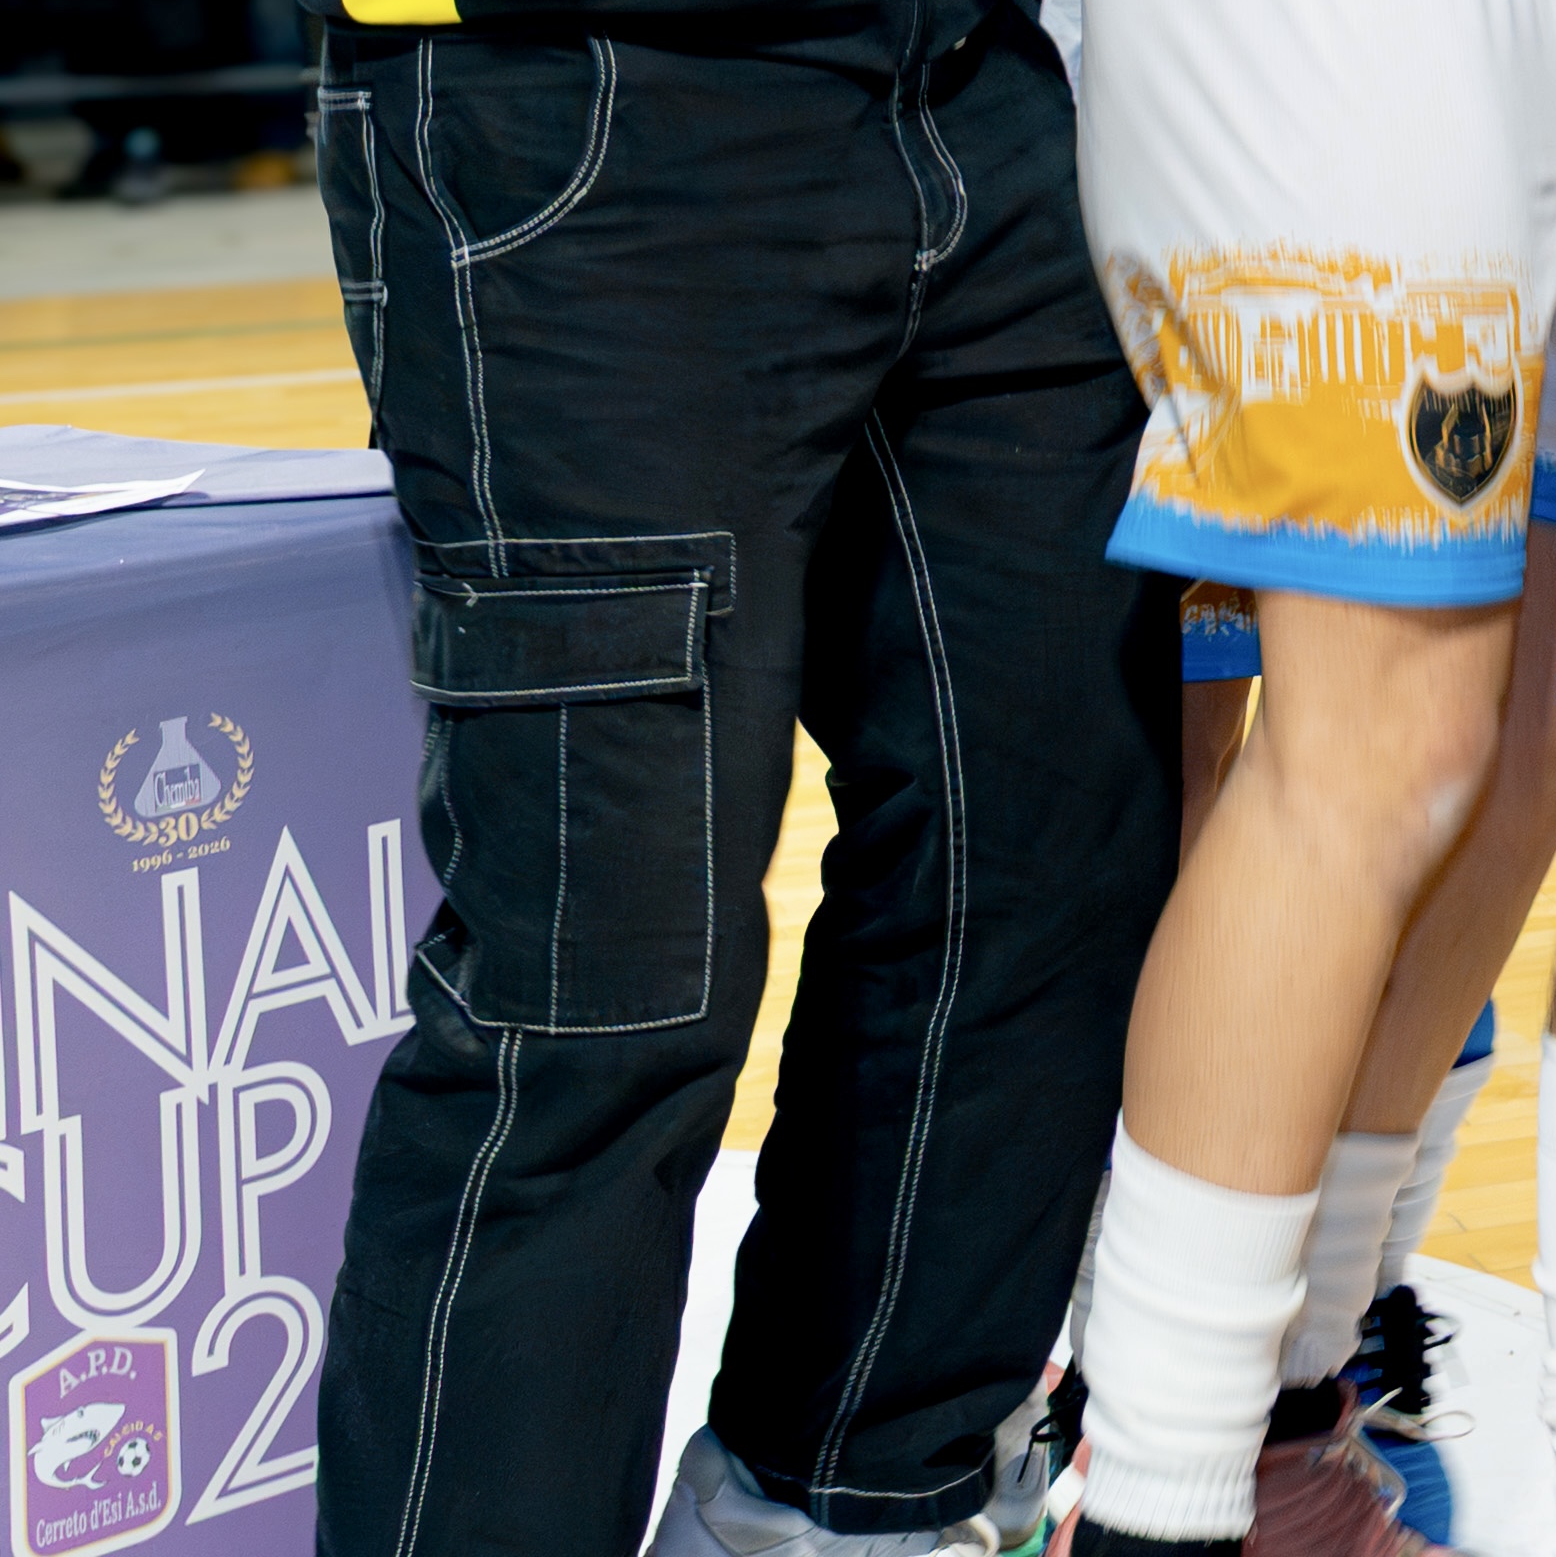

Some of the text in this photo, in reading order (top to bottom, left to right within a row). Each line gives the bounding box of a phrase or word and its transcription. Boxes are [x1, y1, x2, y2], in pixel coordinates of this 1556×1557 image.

[157, 811, 199, 848] 30
[132, 848, 173, 873] 1996
[187, 835, 231, 860] 2026
[59, 1346, 138, 1400] A.P.D.
[36, 1481, 162, 1549] Cerreto d'Esi A.s.d.
